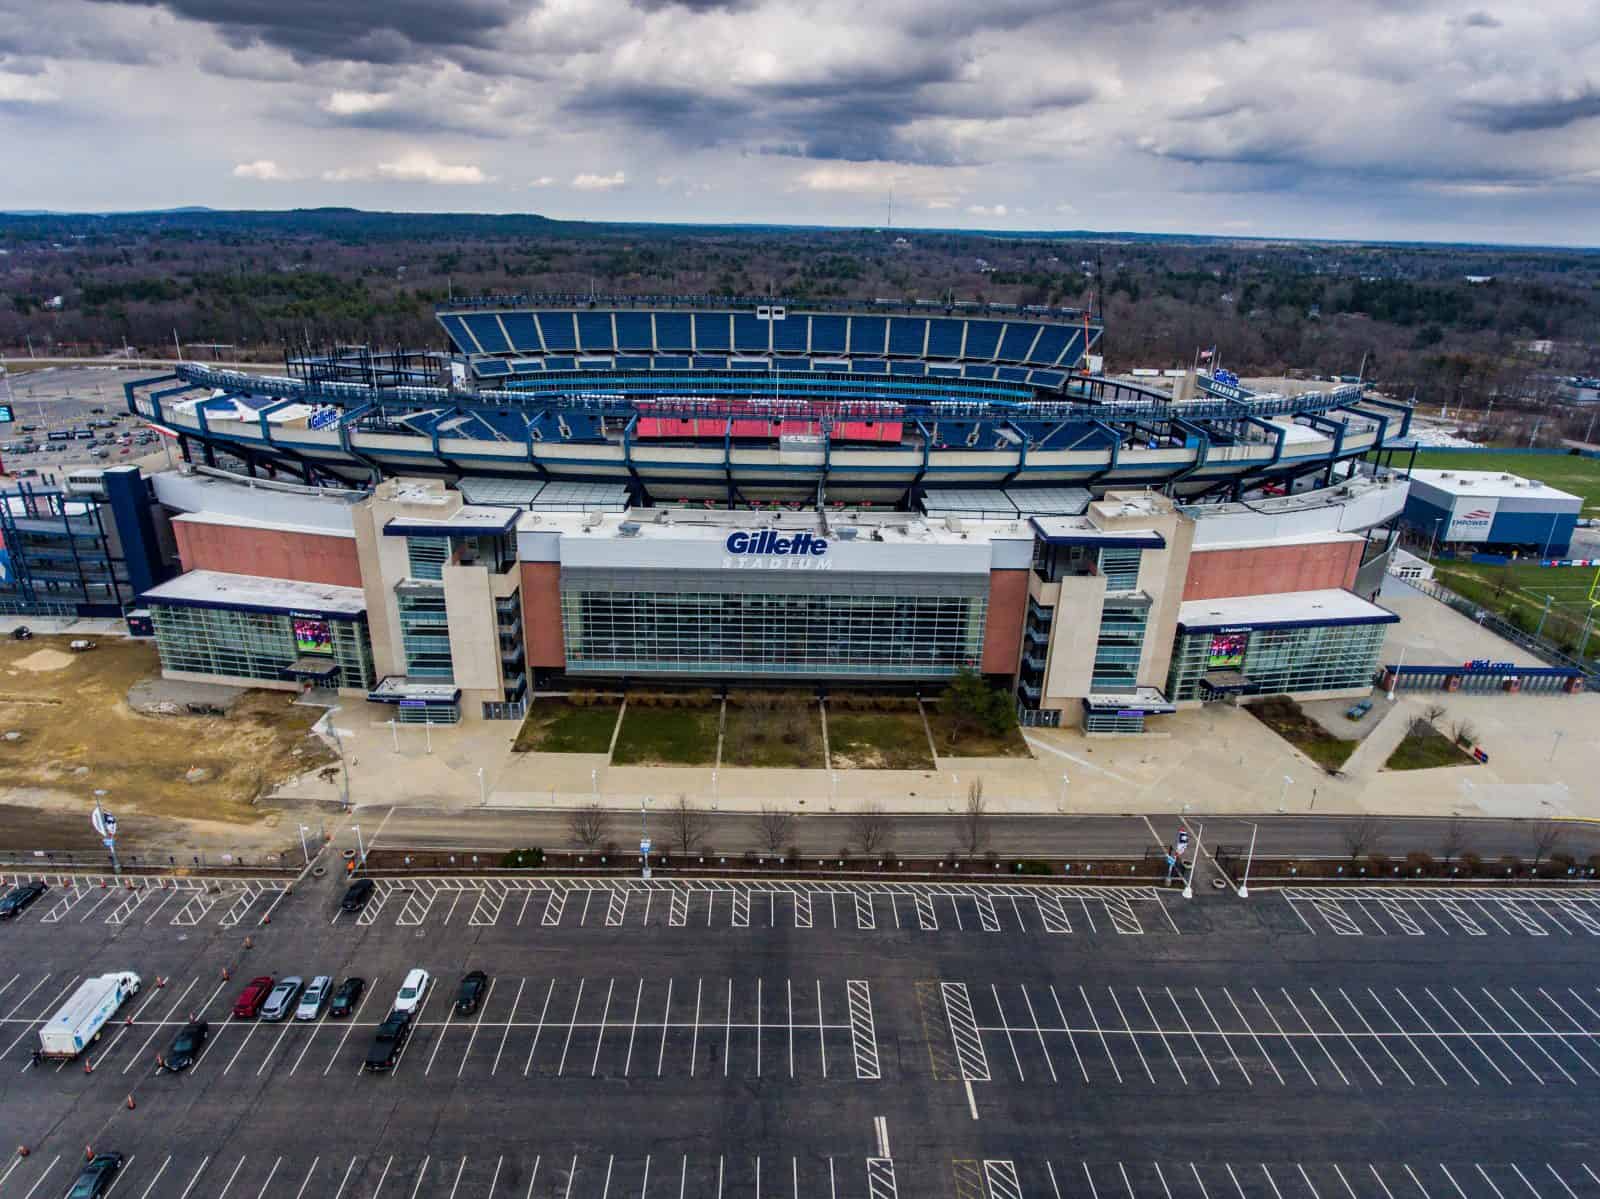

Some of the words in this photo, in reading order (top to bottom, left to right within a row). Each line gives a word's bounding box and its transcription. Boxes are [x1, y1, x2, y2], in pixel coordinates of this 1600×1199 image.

[1210, 382, 1240, 399] STADIUM
[726, 530, 828, 555] Gillette
[721, 558, 832, 569] STADIUM
